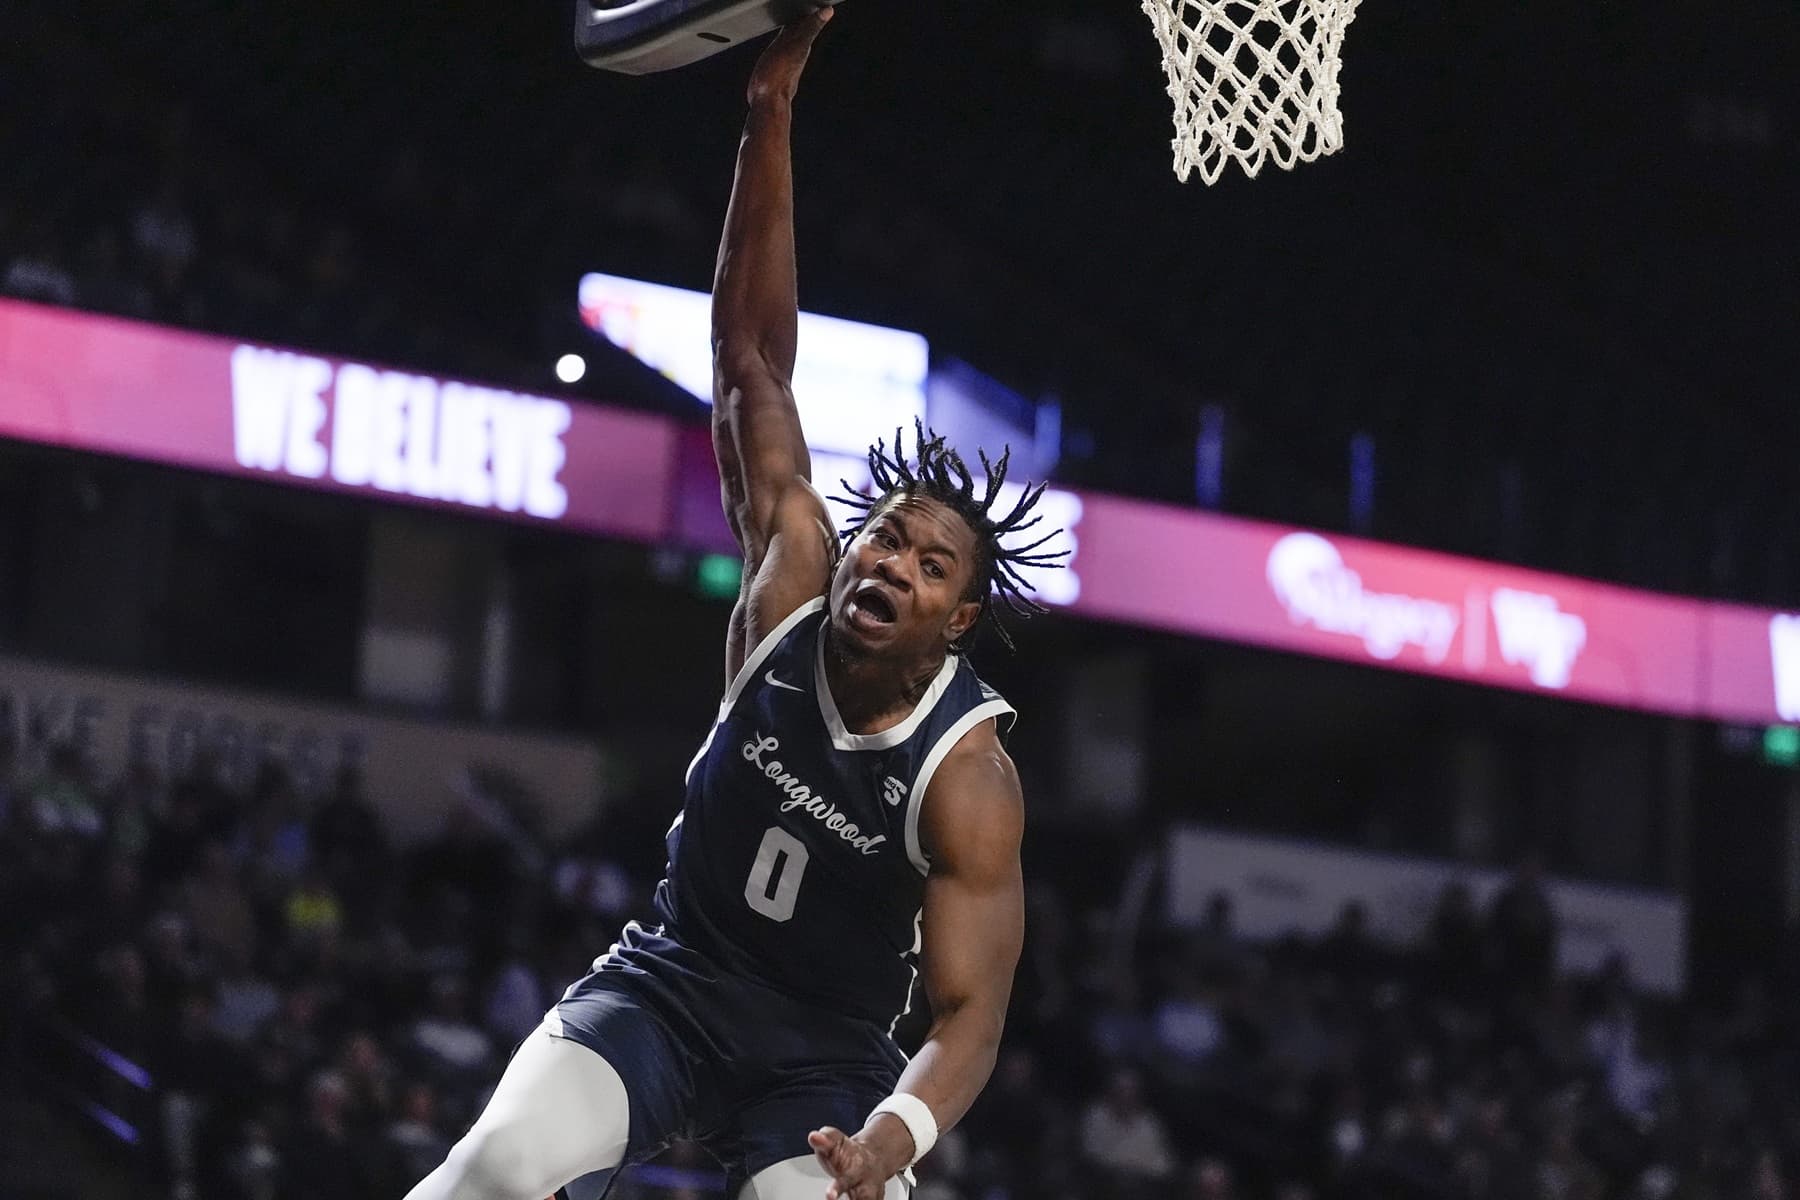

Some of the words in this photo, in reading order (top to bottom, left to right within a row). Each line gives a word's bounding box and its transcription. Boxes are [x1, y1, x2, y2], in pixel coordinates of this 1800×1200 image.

[231, 344, 333, 479] WE
[331, 362, 572, 519] BELIEVE
[742, 731, 887, 855] Longwood
[744, 826, 810, 922] 0
